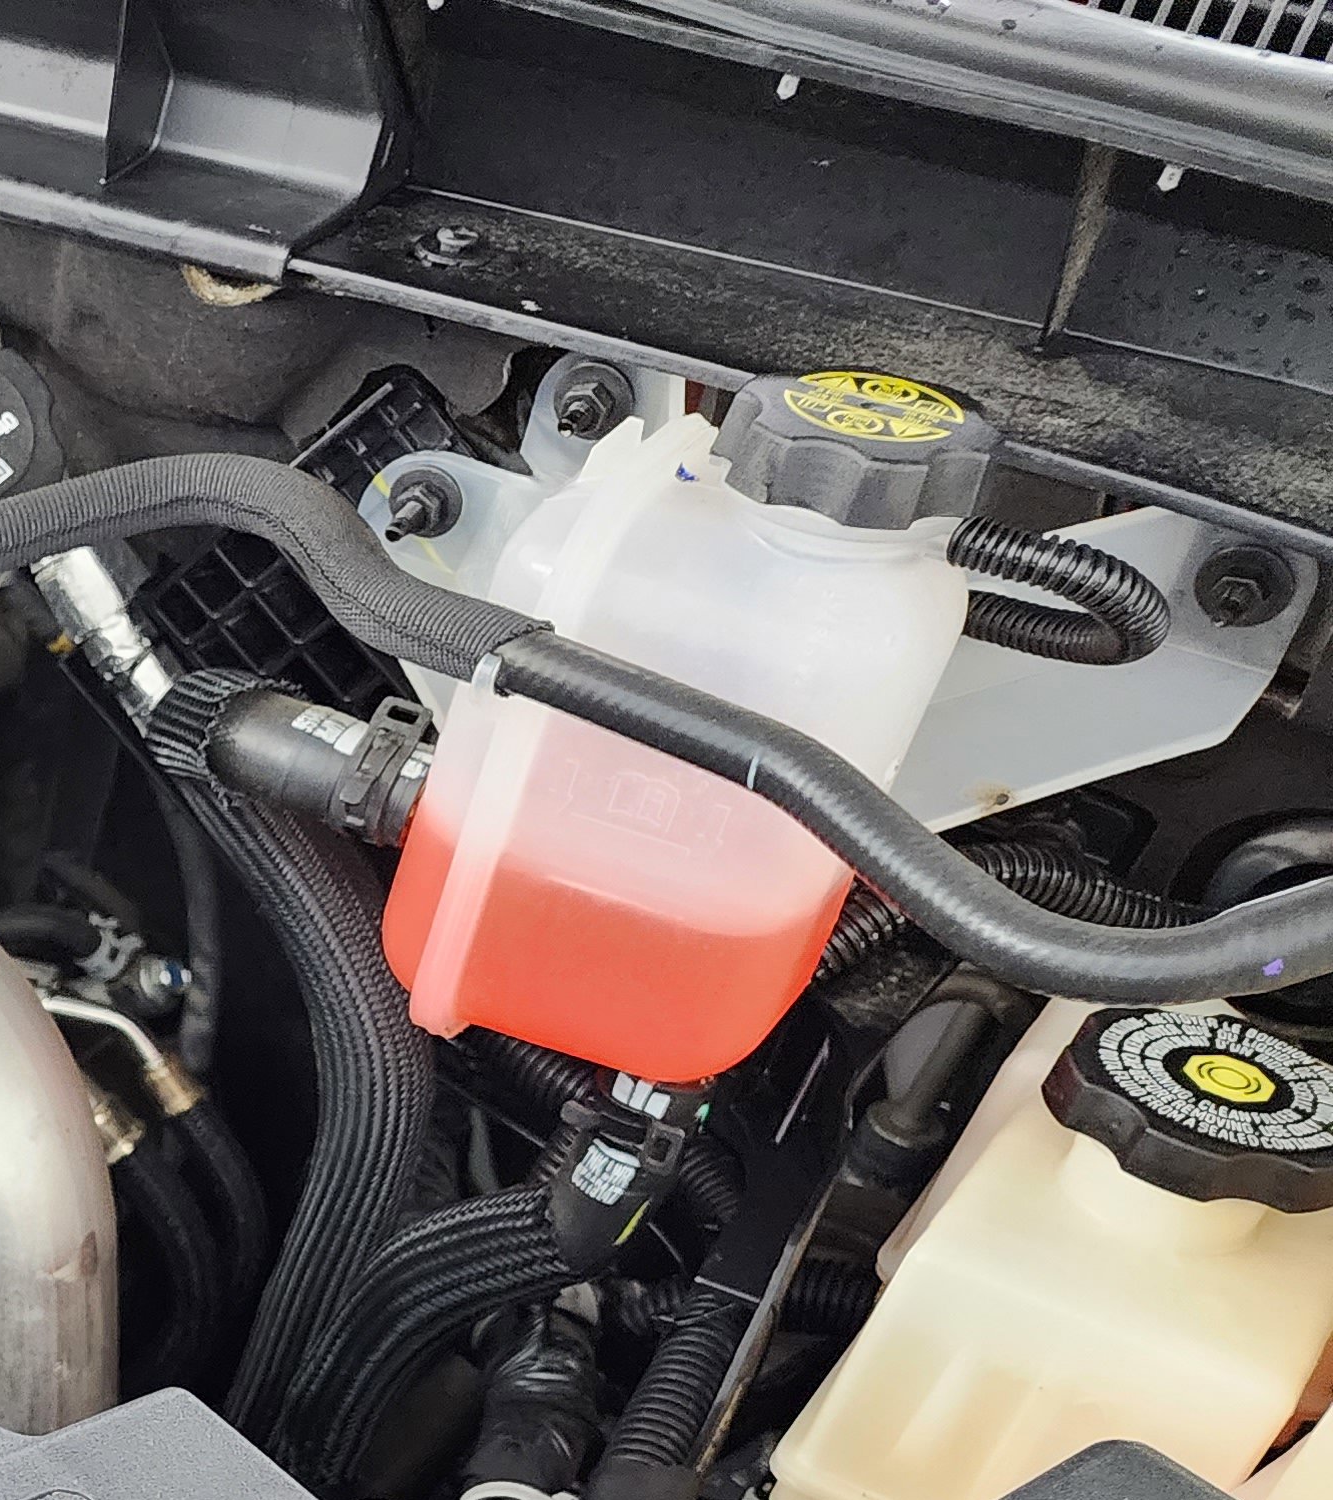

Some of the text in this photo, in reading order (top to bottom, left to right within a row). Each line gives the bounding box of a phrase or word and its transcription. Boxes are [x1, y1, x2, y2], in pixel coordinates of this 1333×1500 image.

[1215, 1037, 1254, 1056] D'UN
[1255, 1053, 1301, 1081] BIDON
[1216, 1028, 1238, 1042] DU
[1242, 1038, 1301, 1067] LIQUIDE
[1245, 1028, 1316, 1064] BOUCHON
[1109, 1070, 1148, 1097] FLUID
[1139, 1094, 1186, 1122] FROM
[1183, 1117, 1196, 1129] A
[1197, 1122, 1260, 1148] SEALED
[1129, 1069, 1177, 1103] BEFORE
[1259, 1124, 1292, 1138] USE
[1198, 1099, 1252, 1123] CLEAN
[1251, 1108, 1302, 1124] FILLER
